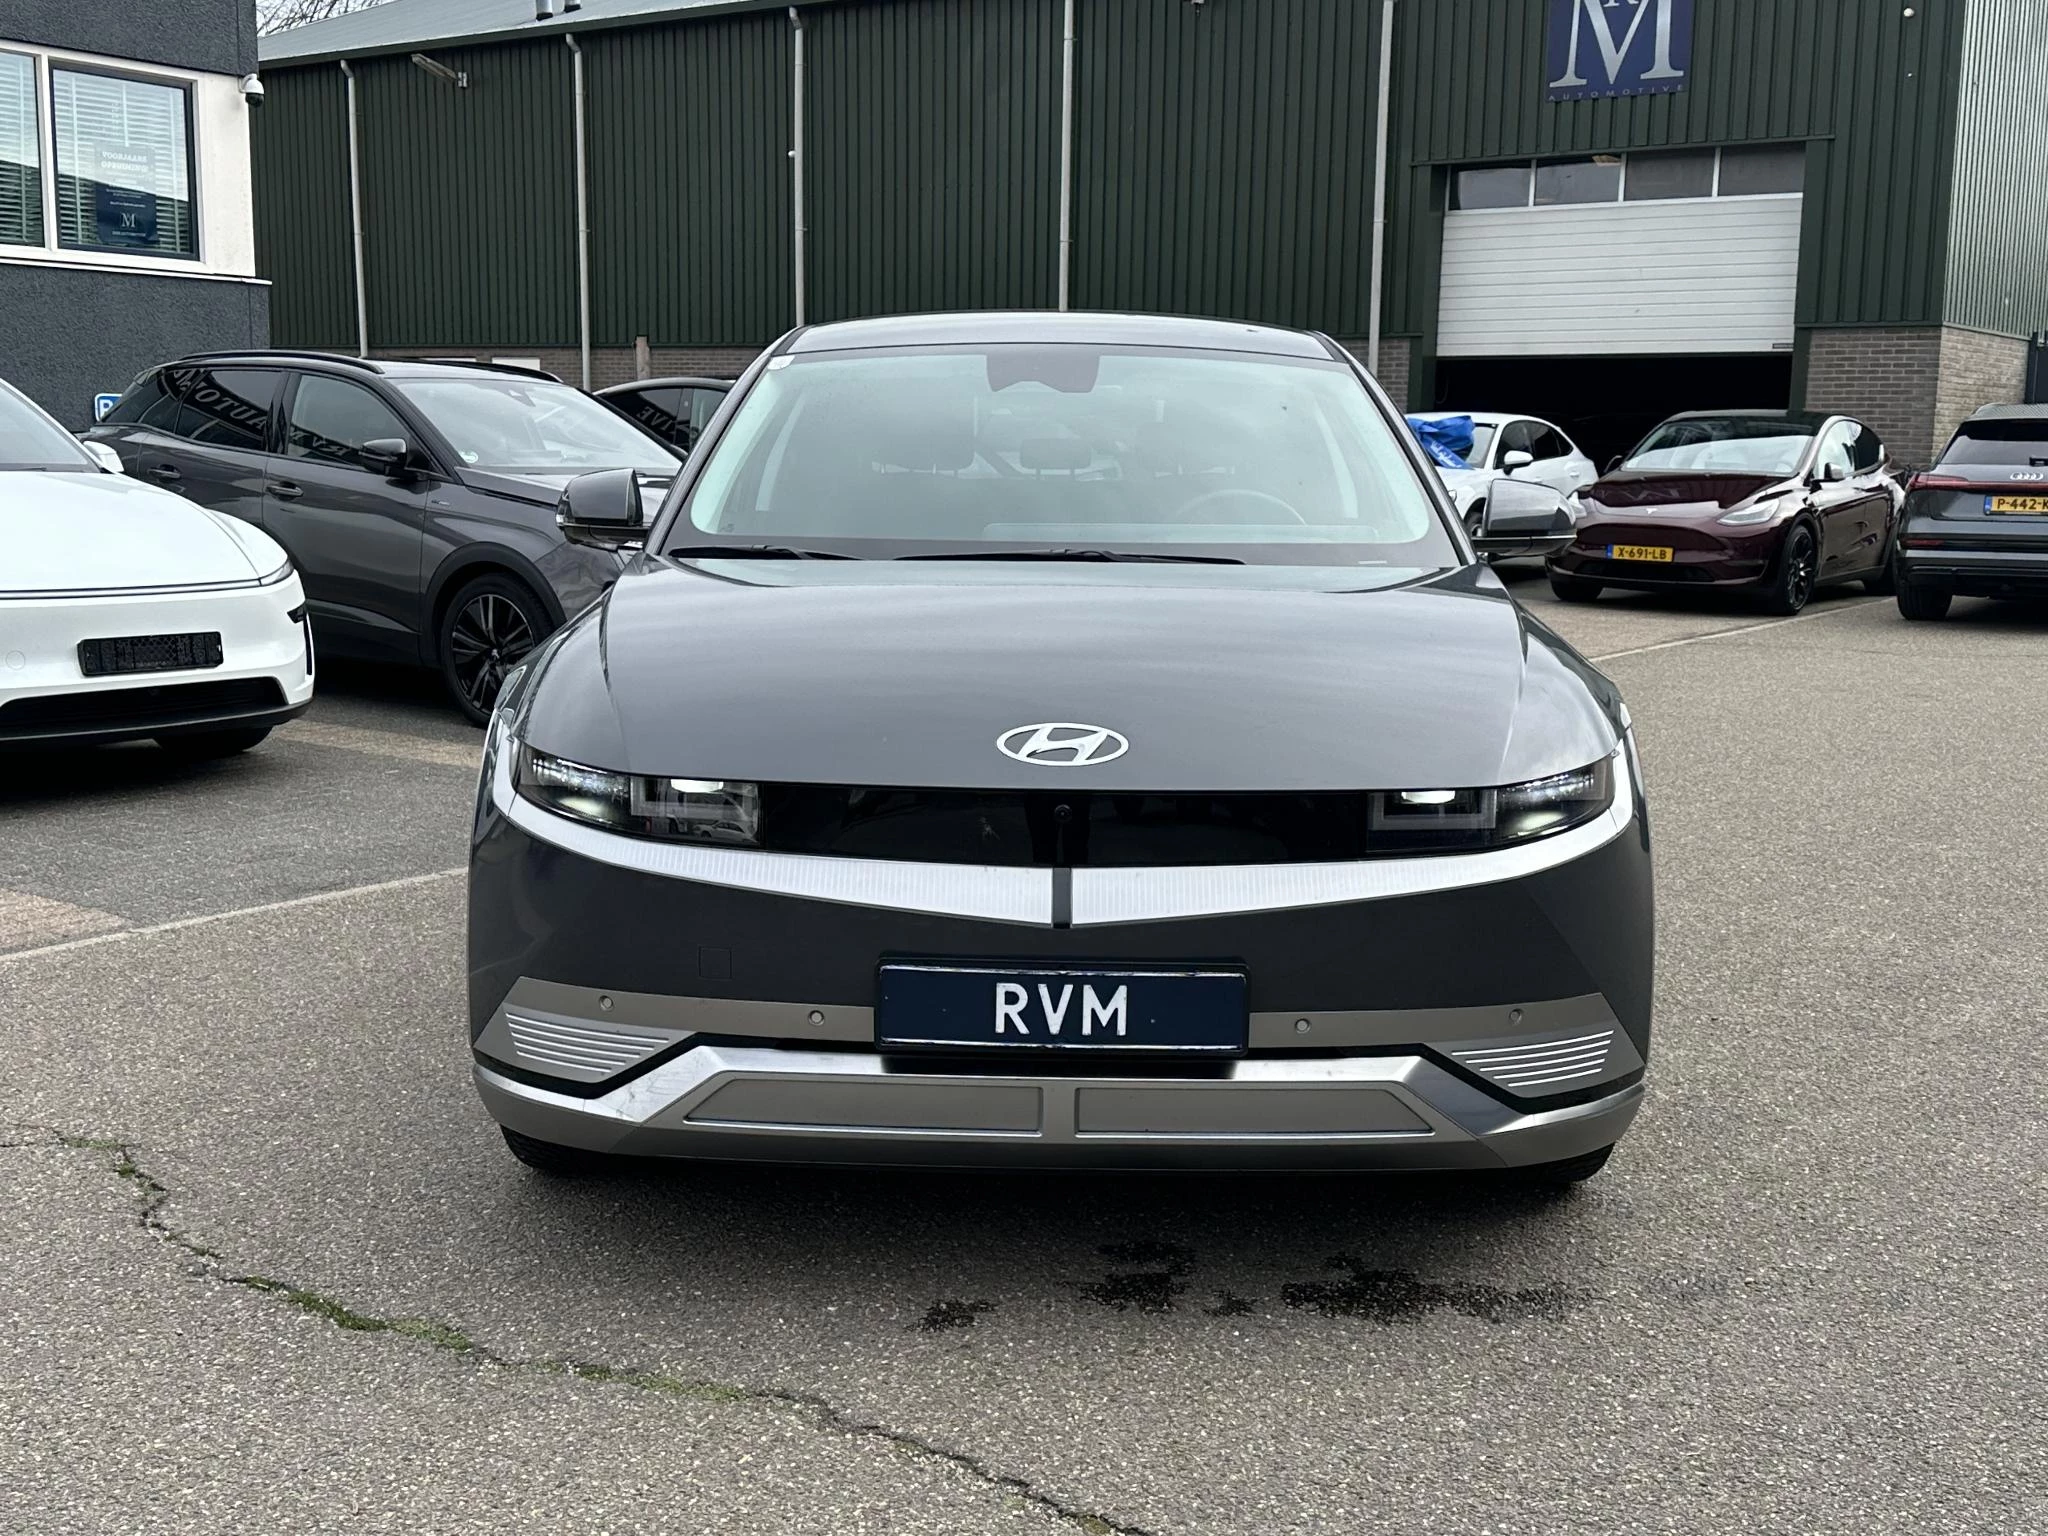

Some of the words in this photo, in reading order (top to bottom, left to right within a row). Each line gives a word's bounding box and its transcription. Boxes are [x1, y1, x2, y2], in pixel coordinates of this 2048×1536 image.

[1548, 84, 1683, 101] AUTOMOTIVE
[1617, 546, 1667, 560] X-691-LB
[995, 982, 1127, 1036] RVM
